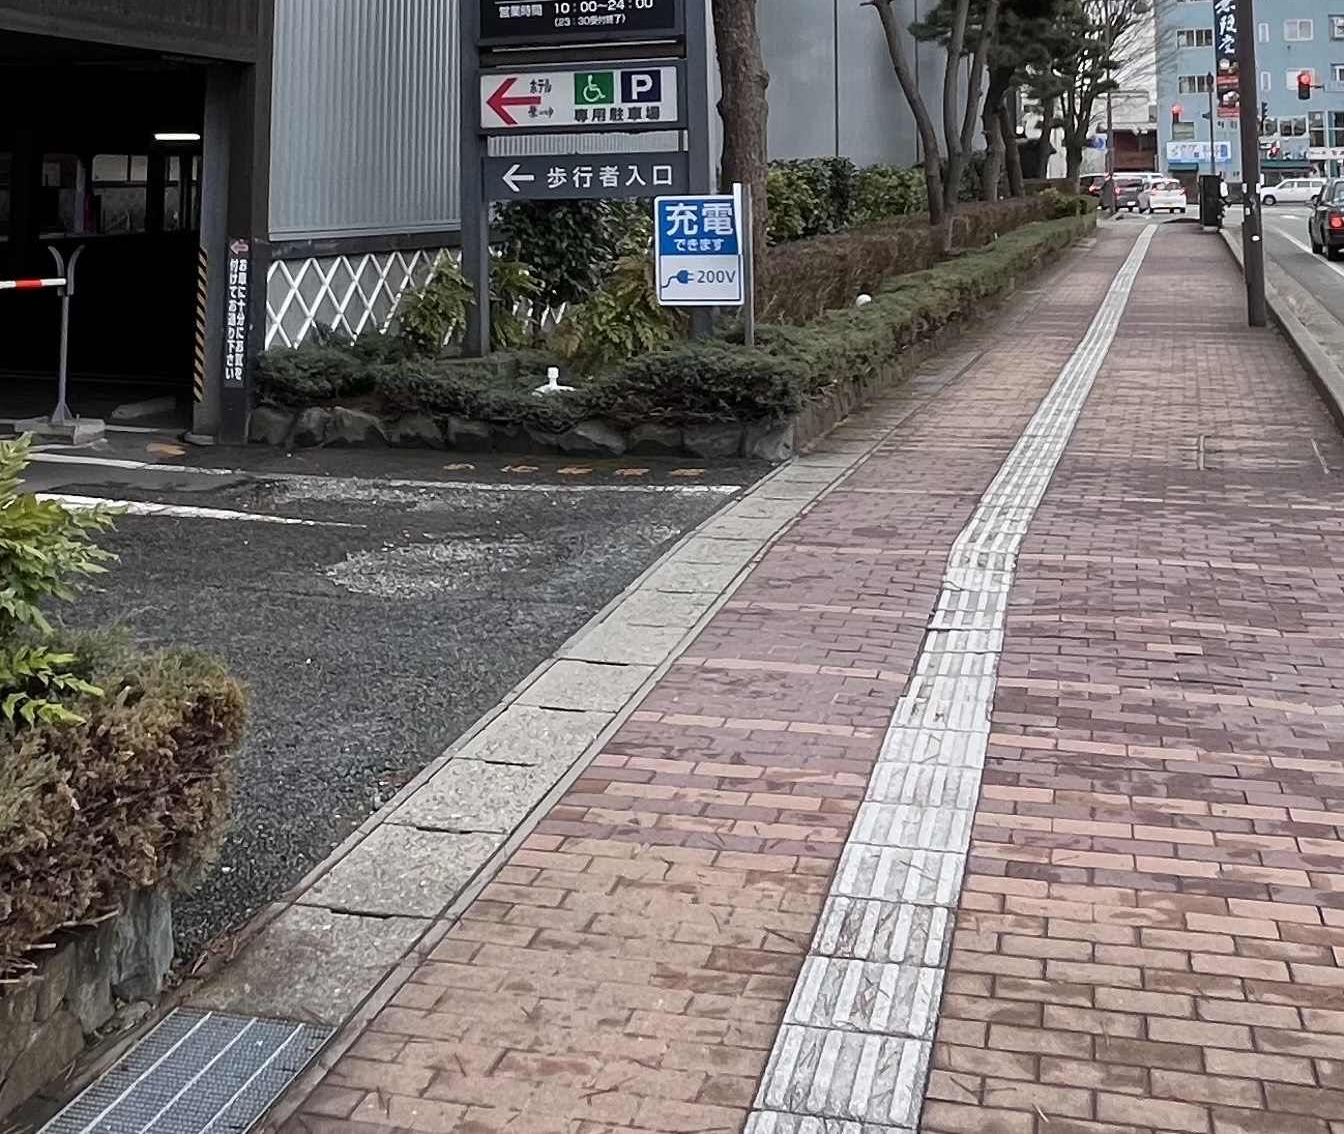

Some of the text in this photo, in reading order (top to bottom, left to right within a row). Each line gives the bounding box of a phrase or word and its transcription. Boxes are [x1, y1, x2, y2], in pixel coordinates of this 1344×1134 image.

[499, 4, 543, 18] 営業時間
[529, 79, 553, 94] ホテル
[574, 106, 661, 123] 専用駐車場
[546, 165, 673, 189] 歩行者入口
[665, 202, 734, 236] 充電
[673, 238, 725, 252] できます
[697, 270, 736, 283] 200V
